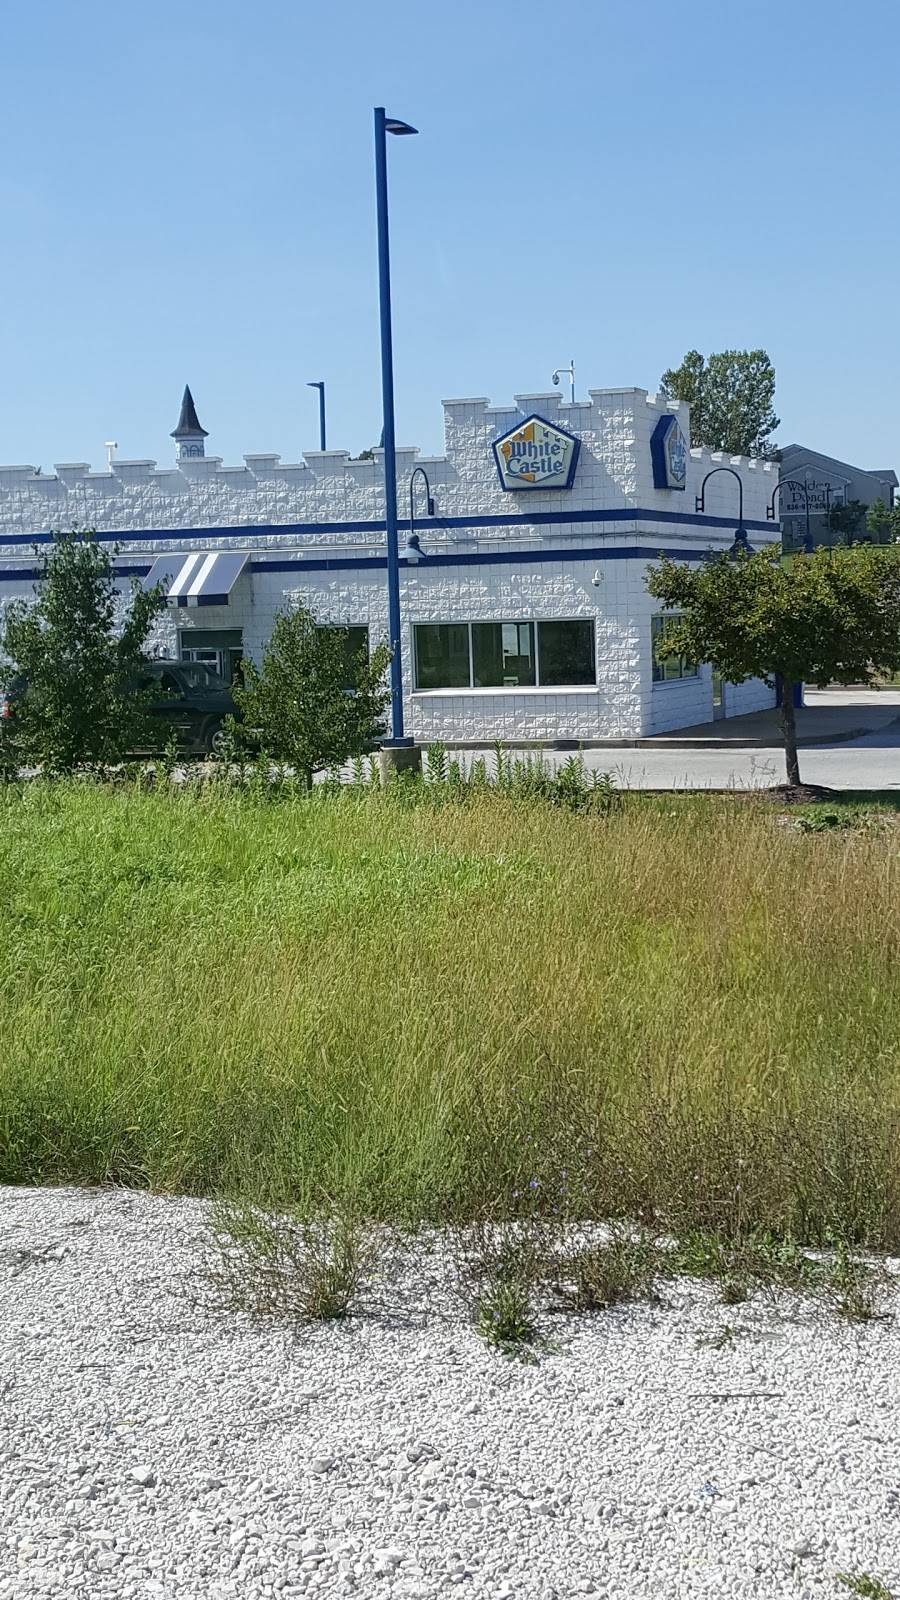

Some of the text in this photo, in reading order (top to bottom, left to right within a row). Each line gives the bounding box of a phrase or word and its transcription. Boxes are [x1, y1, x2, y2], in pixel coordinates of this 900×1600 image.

[510, 441, 561, 460] White
[507, 457, 563, 474] Castle
[792, 490, 825, 503] Pond
